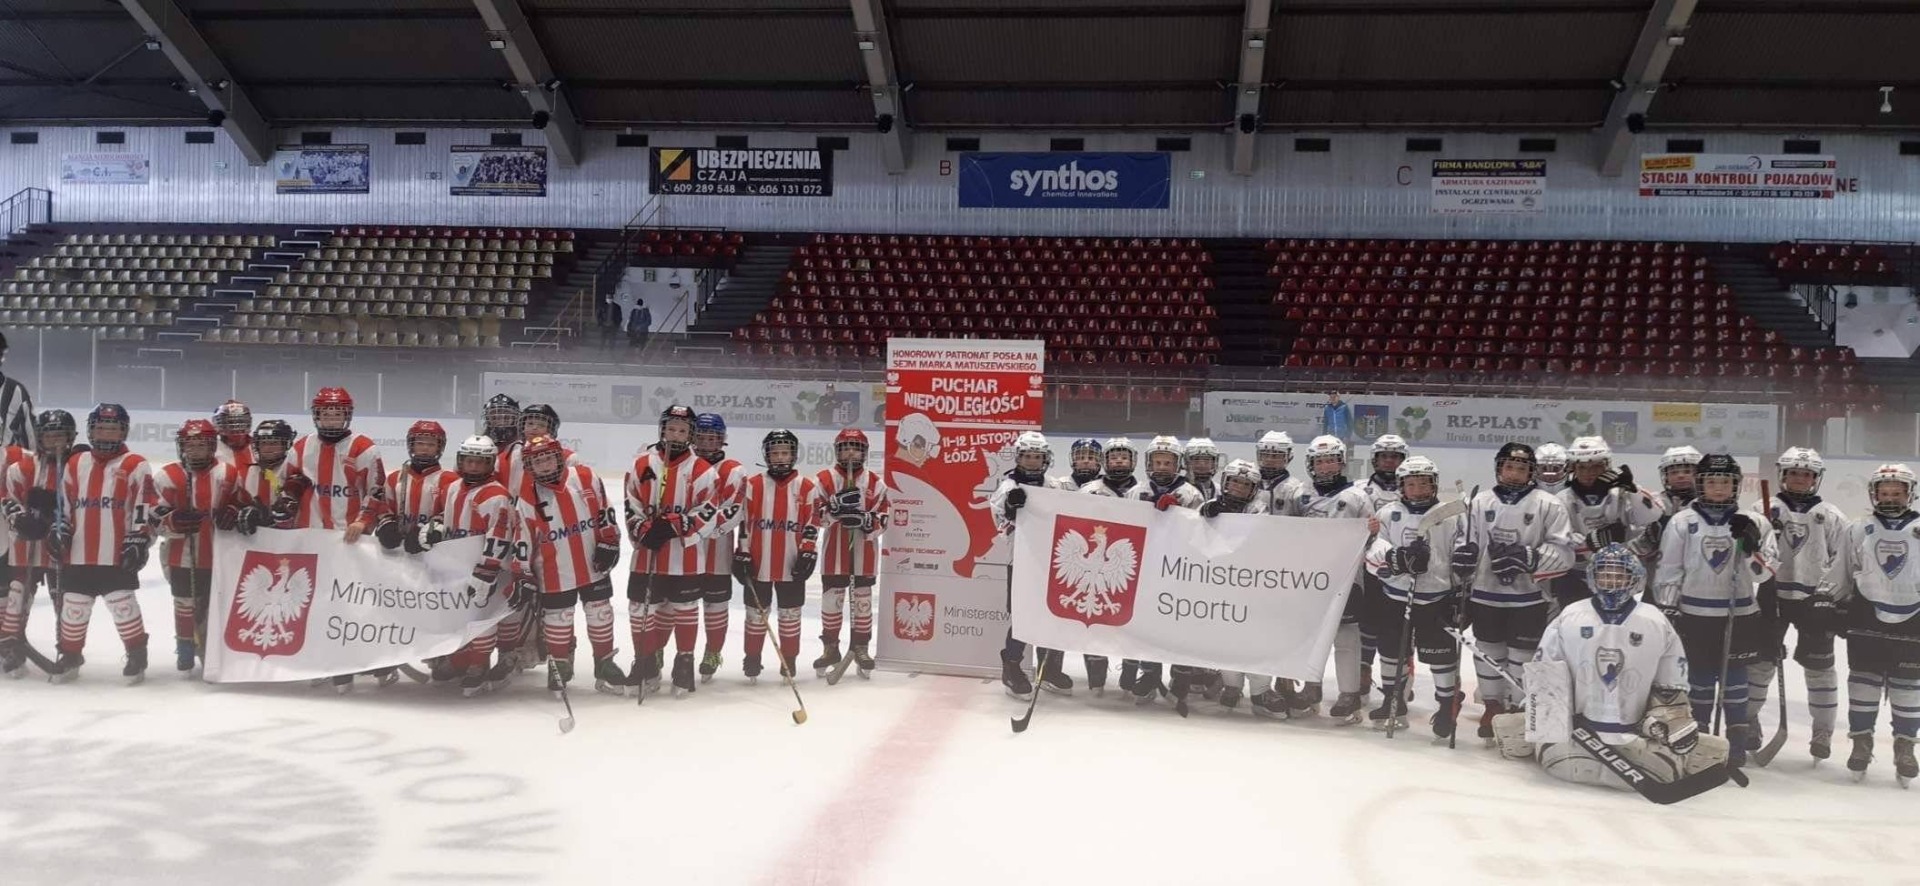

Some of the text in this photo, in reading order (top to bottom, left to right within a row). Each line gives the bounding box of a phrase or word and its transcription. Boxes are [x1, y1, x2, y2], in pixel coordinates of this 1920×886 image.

[697, 150, 821, 170] UBEZPIECZENIA
[1434, 161, 1462, 169] FIRMA
[1465, 161, 1516, 169] HANDLOWA
[697, 170, 748, 182] CZAJA
[1010, 160, 1118, 196] synthos
[1641, 171, 1833, 186] STACJA KONTROLI POJAZDÓW
[673, 184, 822, 194] 609 289 548 606 131 072
[1042, 190, 1076, 198] chemical
[893, 350, 1038, 361] HONOROWY PATRONAT POSŁA NA
[893, 360, 1037, 371] SEJM MARKA MATUSZEWSKIEGO
[931, 377, 998, 394] PUCHAR
[693, 395, 776, 409] RE-PLAST
[904, 391, 1024, 416] NIEPODLEGŁOŚCI
[1446, 415, 1542, 430] RE-PLAST
[942, 431, 1022, 448] 11-12 LISTOPA
[943, 447, 978, 464] ŁÓDŹ
[483, 537, 508, 559] 17
[1161, 554, 1330, 591] Ministerstwo
[944, 606, 1012, 621] Ministerstw
[1157, 592, 1248, 623] Sportu
[326, 615, 416, 647] Sportu
[943, 622, 984, 637] Sportu
[1529, 693, 1538, 732] BAUER
[1572, 727, 1645, 784] BAUER
